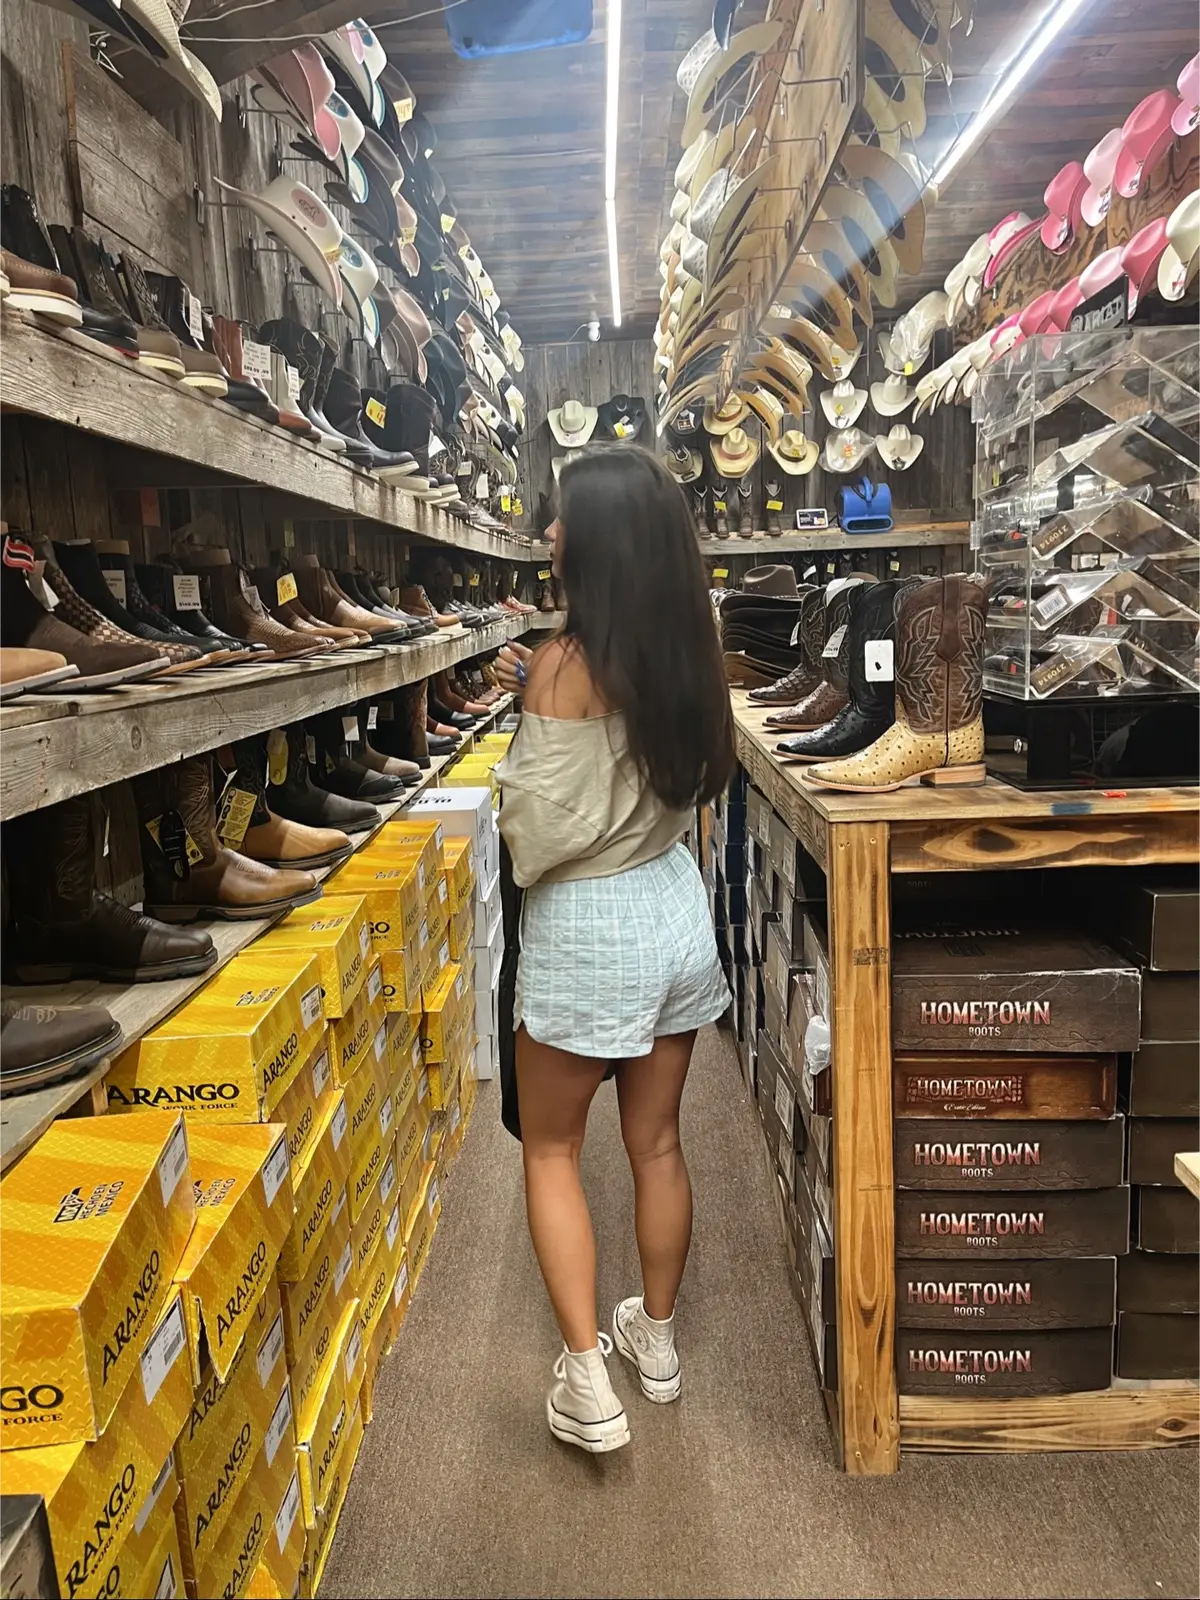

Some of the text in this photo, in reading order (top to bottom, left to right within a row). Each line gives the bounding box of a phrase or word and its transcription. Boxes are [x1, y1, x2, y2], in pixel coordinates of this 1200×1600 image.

[920, 1001, 1051, 1025] HOMETOWN
[342, 1019, 369, 1068] ARANGO
[968, 1026, 1001, 1037] BOOTS
[262, 1032, 298, 1092] ARANGO
[108, 1083, 240, 1107] ARANGO
[917, 1079, 1013, 1097] HOMETOWN
[200, 1102, 238, 1110] FORCE
[352, 1082, 376, 1135] ARANGO
[288, 1106, 312, 1159] RANGO
[914, 1142, 1041, 1166] HOMETOWN
[355, 1145, 381, 1200] ARANGO
[961, 1168, 994, 1178] BOOTS
[302, 1179, 332, 1253] ARANGO
[920, 1213, 1045, 1235] HOMETOWN
[966, 1236, 998, 1246] BOOTS
[217, 1241, 266, 1347] ARANGO
[299, 1256, 330, 1337] ARANGO
[907, 1281, 1032, 1305] HOMETOWN
[103, 1250, 160, 1386] ARANGO
[953, 1307, 986, 1316] BOOTS
[908, 1350, 1033, 1373] HOMETOWN
[955, 1374, 987, 1384] BOOTS
[3, 1413, 63, 1427] FORCE
[195, 1422, 251, 1549] ARANGO
[65, 1463, 136, 1599] RANGO
[90, 1536, 114, 1575] WORK
[113, 1487, 139, 1530] FORCE
[222, 1511, 262, 1600] RANGO
